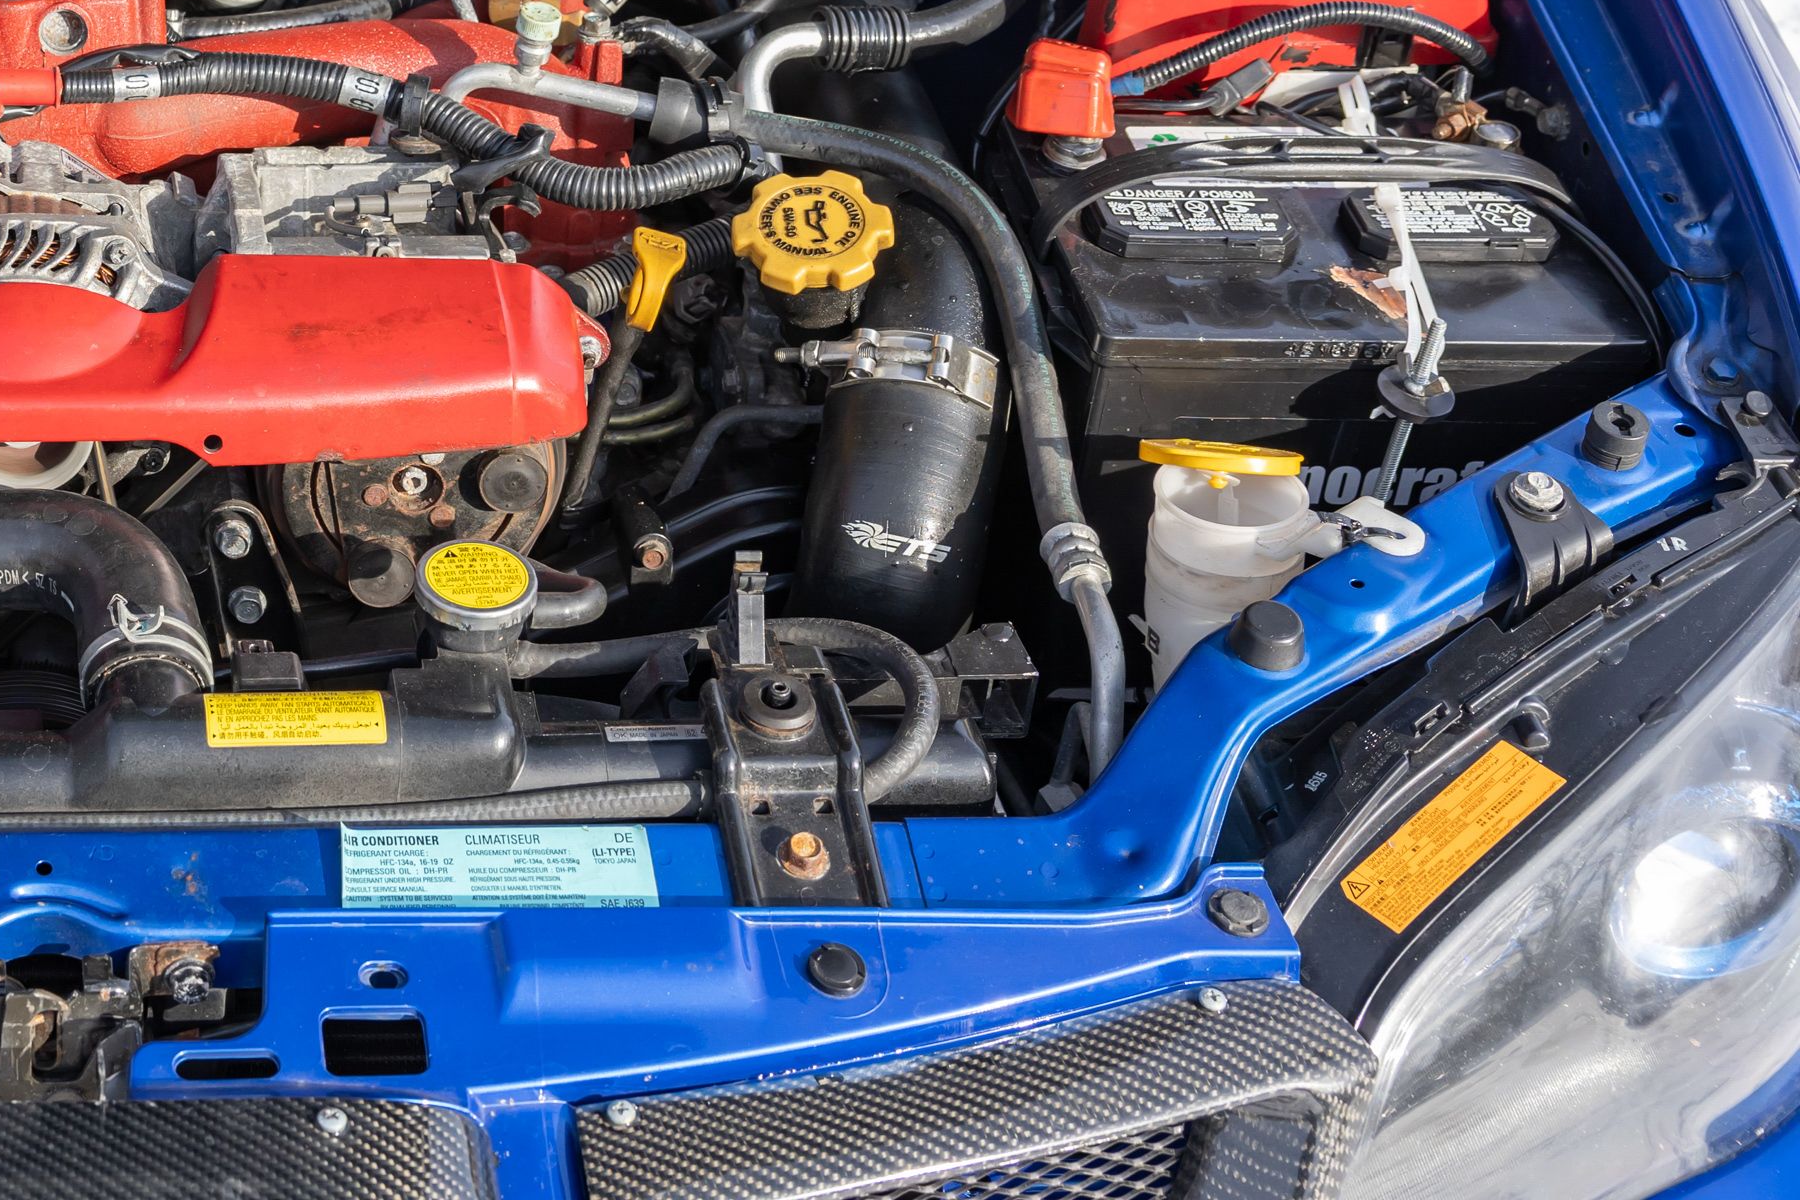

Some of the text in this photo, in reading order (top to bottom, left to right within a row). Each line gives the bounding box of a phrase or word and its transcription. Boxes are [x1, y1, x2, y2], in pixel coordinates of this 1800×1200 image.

[1123, 188, 1185, 198] DANGER
[1199, 190, 1255, 199] POISON
[761, 186, 832, 256] SEE OWNER'S MANUAL
[783, 207, 798, 238] 5W-30
[829, 191, 862, 248] ENGINE OIL
[1656, 536, 1689, 552] 1R
[1304, 770, 1328, 792] 1615
[361, 835, 440, 846] CONDITIONER
[465, 833, 540, 846] CLIMATISEUR
[614, 832, 634, 843] DE
[465, 848, 512, 857] CHARGEMENT
[513, 848, 522, 856] DU
[591, 847, 636, 858] (LI-TYPE)
[379, 859, 416, 867] HFC-134a,
[443, 858, 454, 866] OZ
[514, 857, 545, 865] HFC-134a,
[593, 857, 615, 865] TOKYO
[399, 867, 412, 875] OIL
[423, 867, 449, 875] DH-PR
[499, 866, 549, 874] COMPRESSEUR
[373, 885, 398, 893] SERVICE
[600, 898, 645, 908] SAE J639
